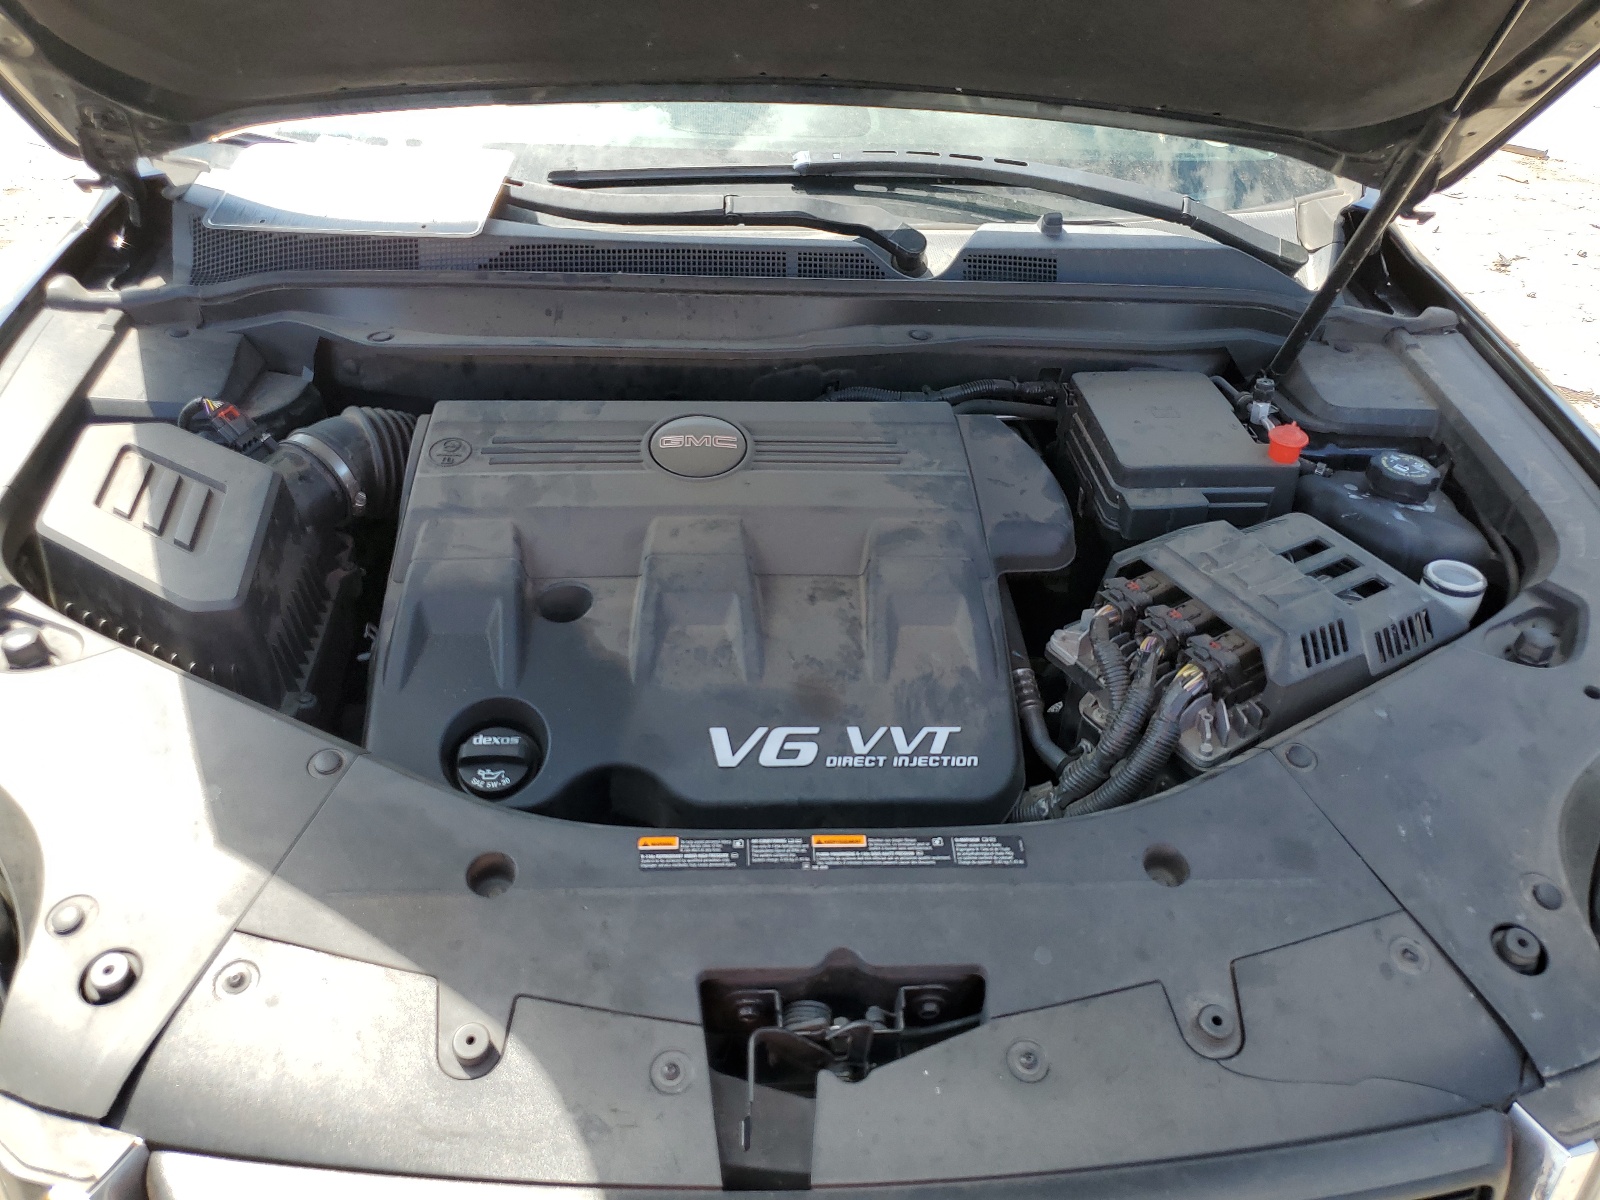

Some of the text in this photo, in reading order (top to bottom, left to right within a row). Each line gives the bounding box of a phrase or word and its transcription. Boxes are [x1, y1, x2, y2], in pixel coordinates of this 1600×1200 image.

[659, 435, 738, 449] GMC
[472, 734, 519, 745] dexos
[709, 726, 962, 768] V6 VVT
[825, 755, 979, 768] DIRECT INJECTION
